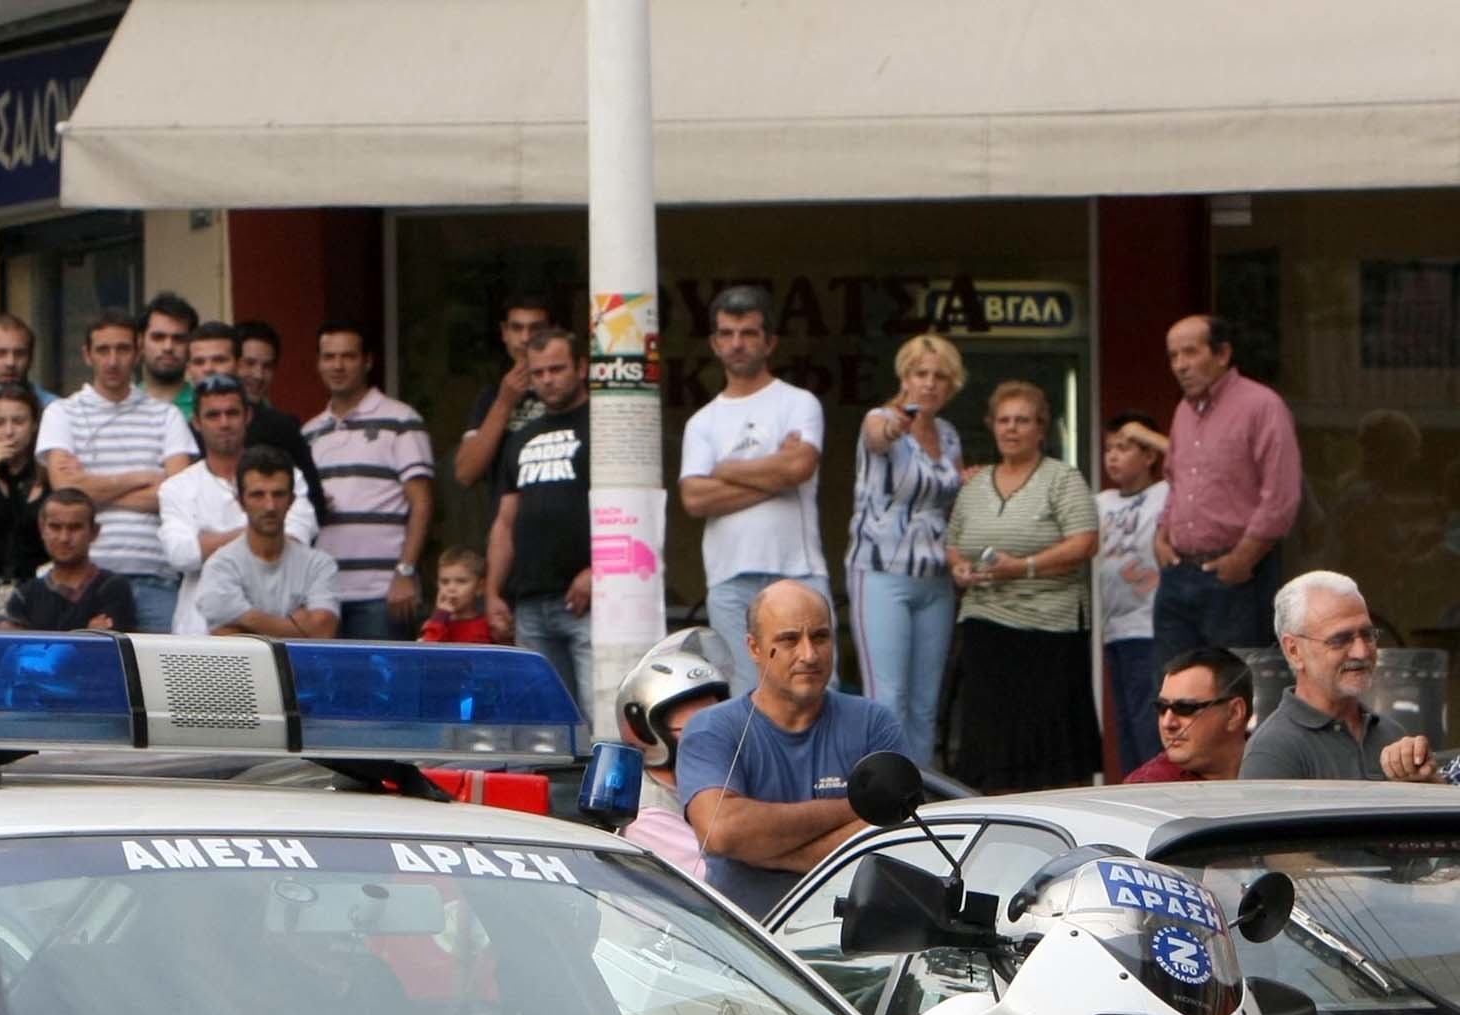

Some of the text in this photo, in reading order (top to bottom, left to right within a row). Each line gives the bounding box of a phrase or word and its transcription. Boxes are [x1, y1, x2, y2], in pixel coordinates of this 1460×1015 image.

[122, 839, 579, 885] ΑΜΕΣΗ ΔΡΑΣΗ
[1109, 865, 1216, 908] ΑΜΕΣΗ
[1116, 886, 1223, 931] ΔΡΑΣΗ
[1172, 962, 1198, 976] 100
